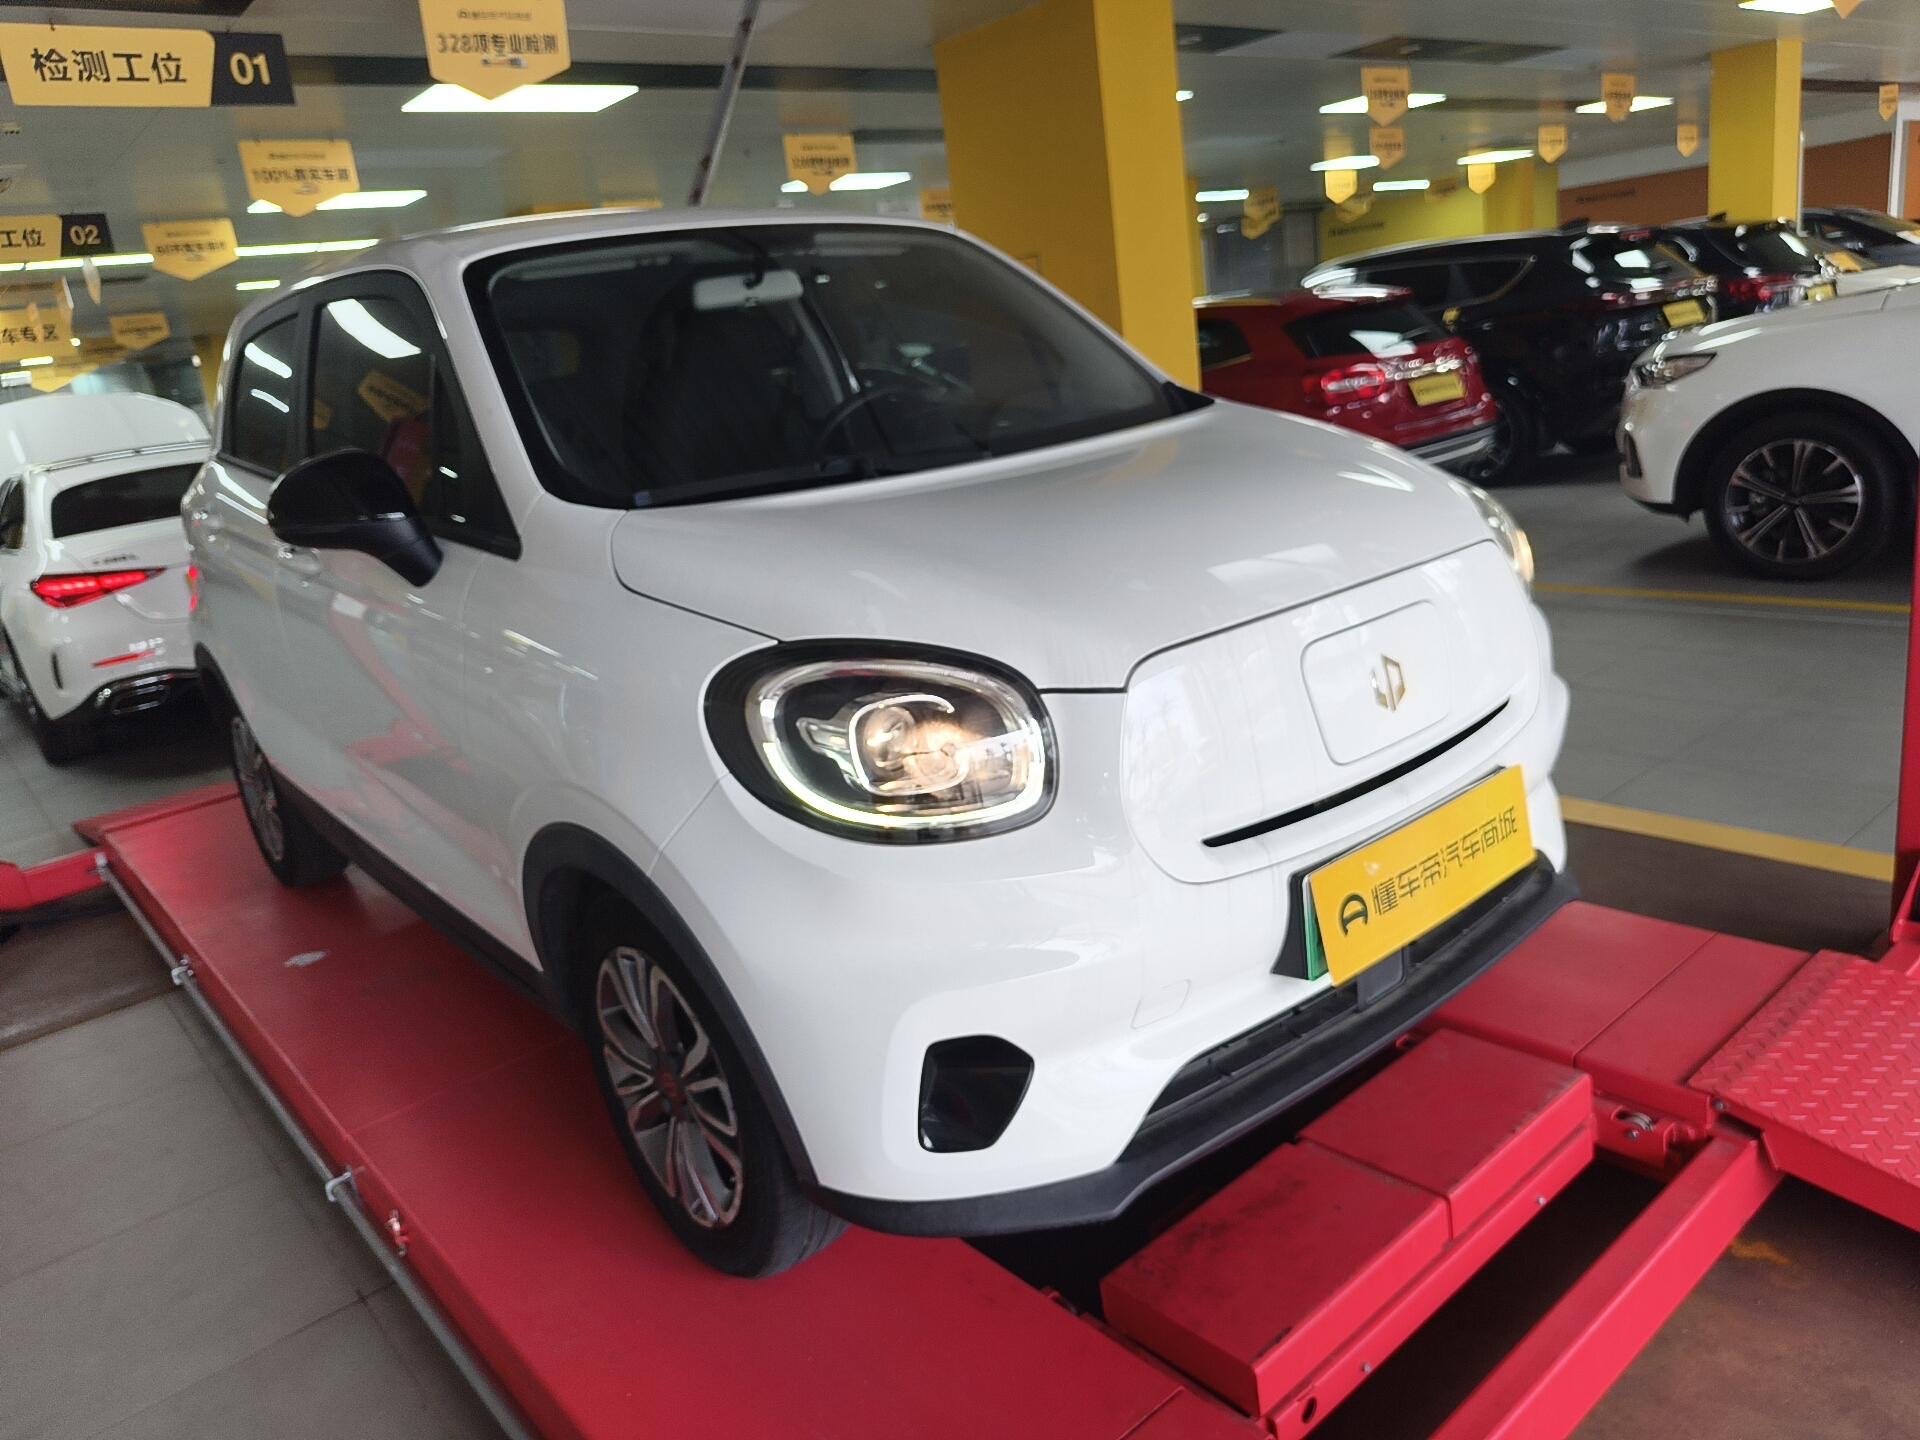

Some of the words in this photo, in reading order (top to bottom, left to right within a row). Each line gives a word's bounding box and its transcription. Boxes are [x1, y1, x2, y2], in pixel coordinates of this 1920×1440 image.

[31, 48, 188, 84] 检测工位
[230, 52, 272, 86] 01
[70, 224, 101, 246] 02
[1371, 805, 1518, 915] 懂车帝汽车商城
